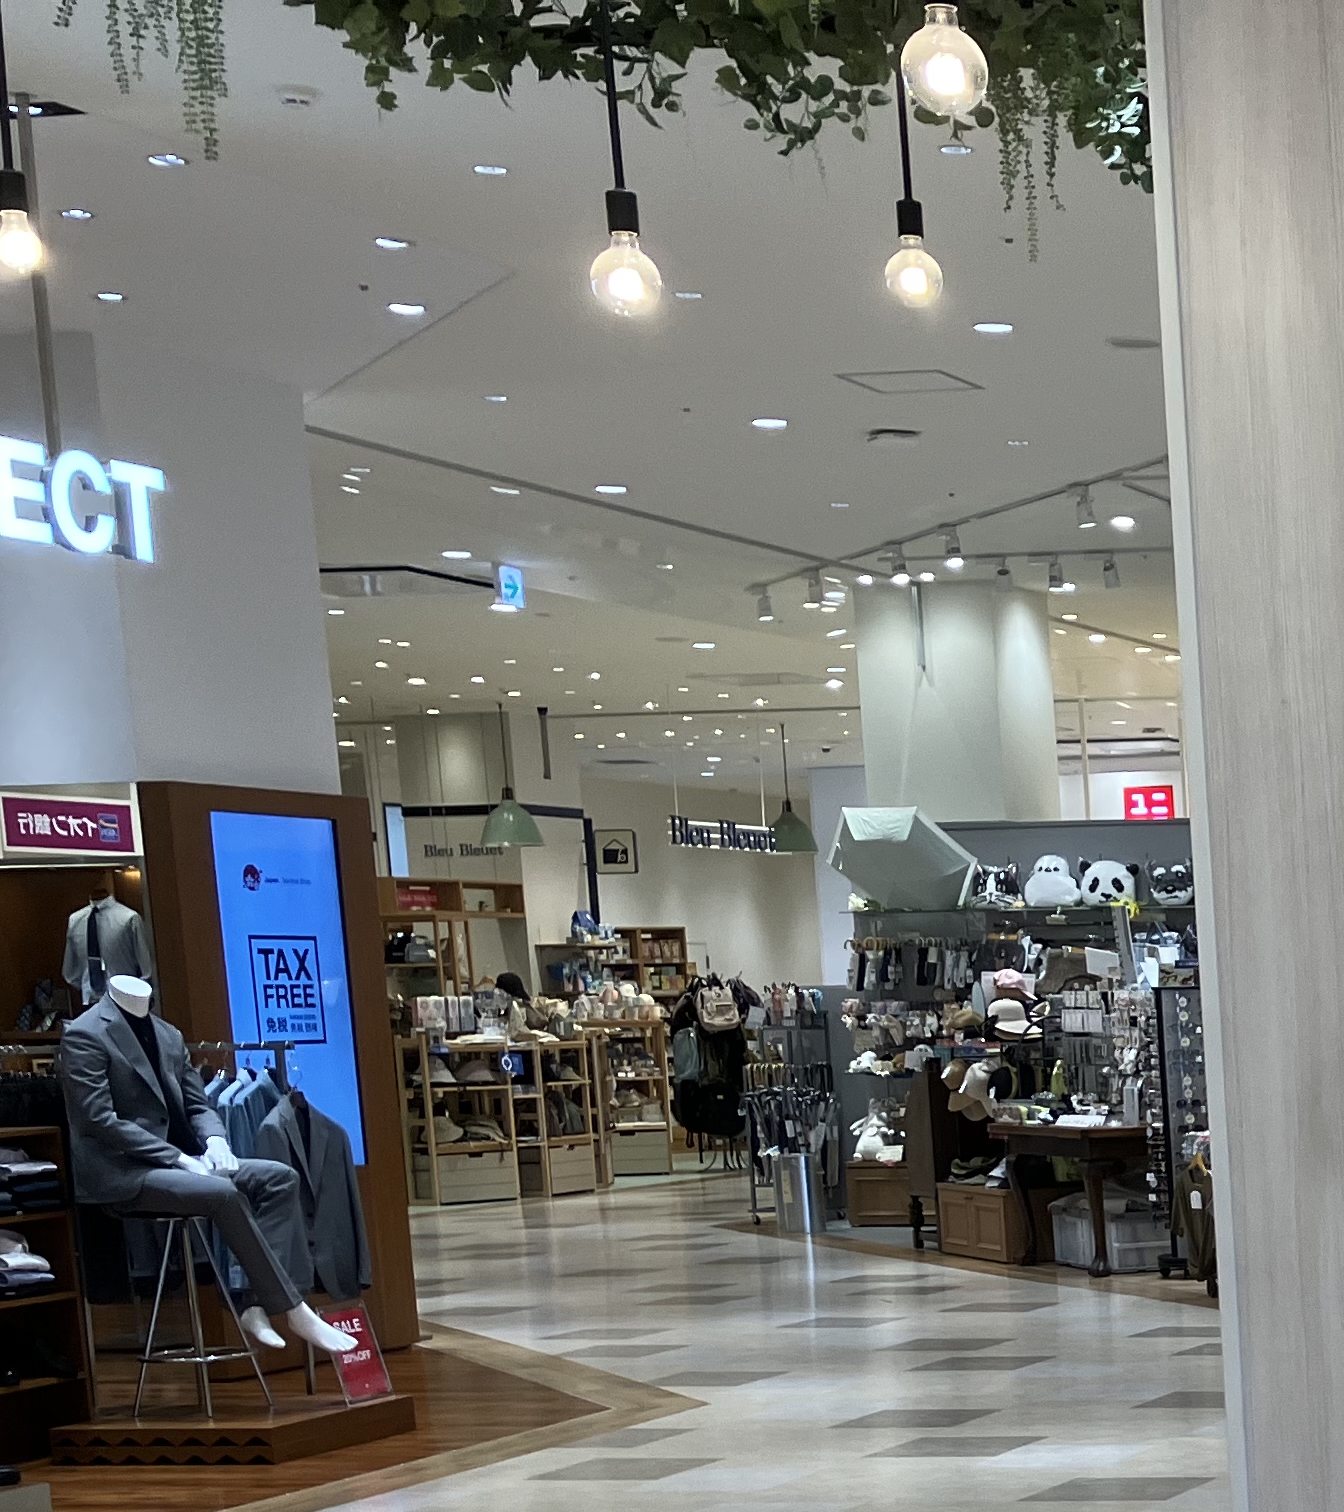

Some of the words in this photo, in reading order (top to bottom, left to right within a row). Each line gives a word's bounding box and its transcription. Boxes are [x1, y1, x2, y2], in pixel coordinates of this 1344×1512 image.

[669, 815, 711, 846] Bleu
[424, 844, 454, 857] Bleu
[459, 843, 504, 856] Bleuet
[257, 947, 313, 981] TAX
[263, 983, 317, 1009] FREE
[333, 1318, 362, 1334] SALE
